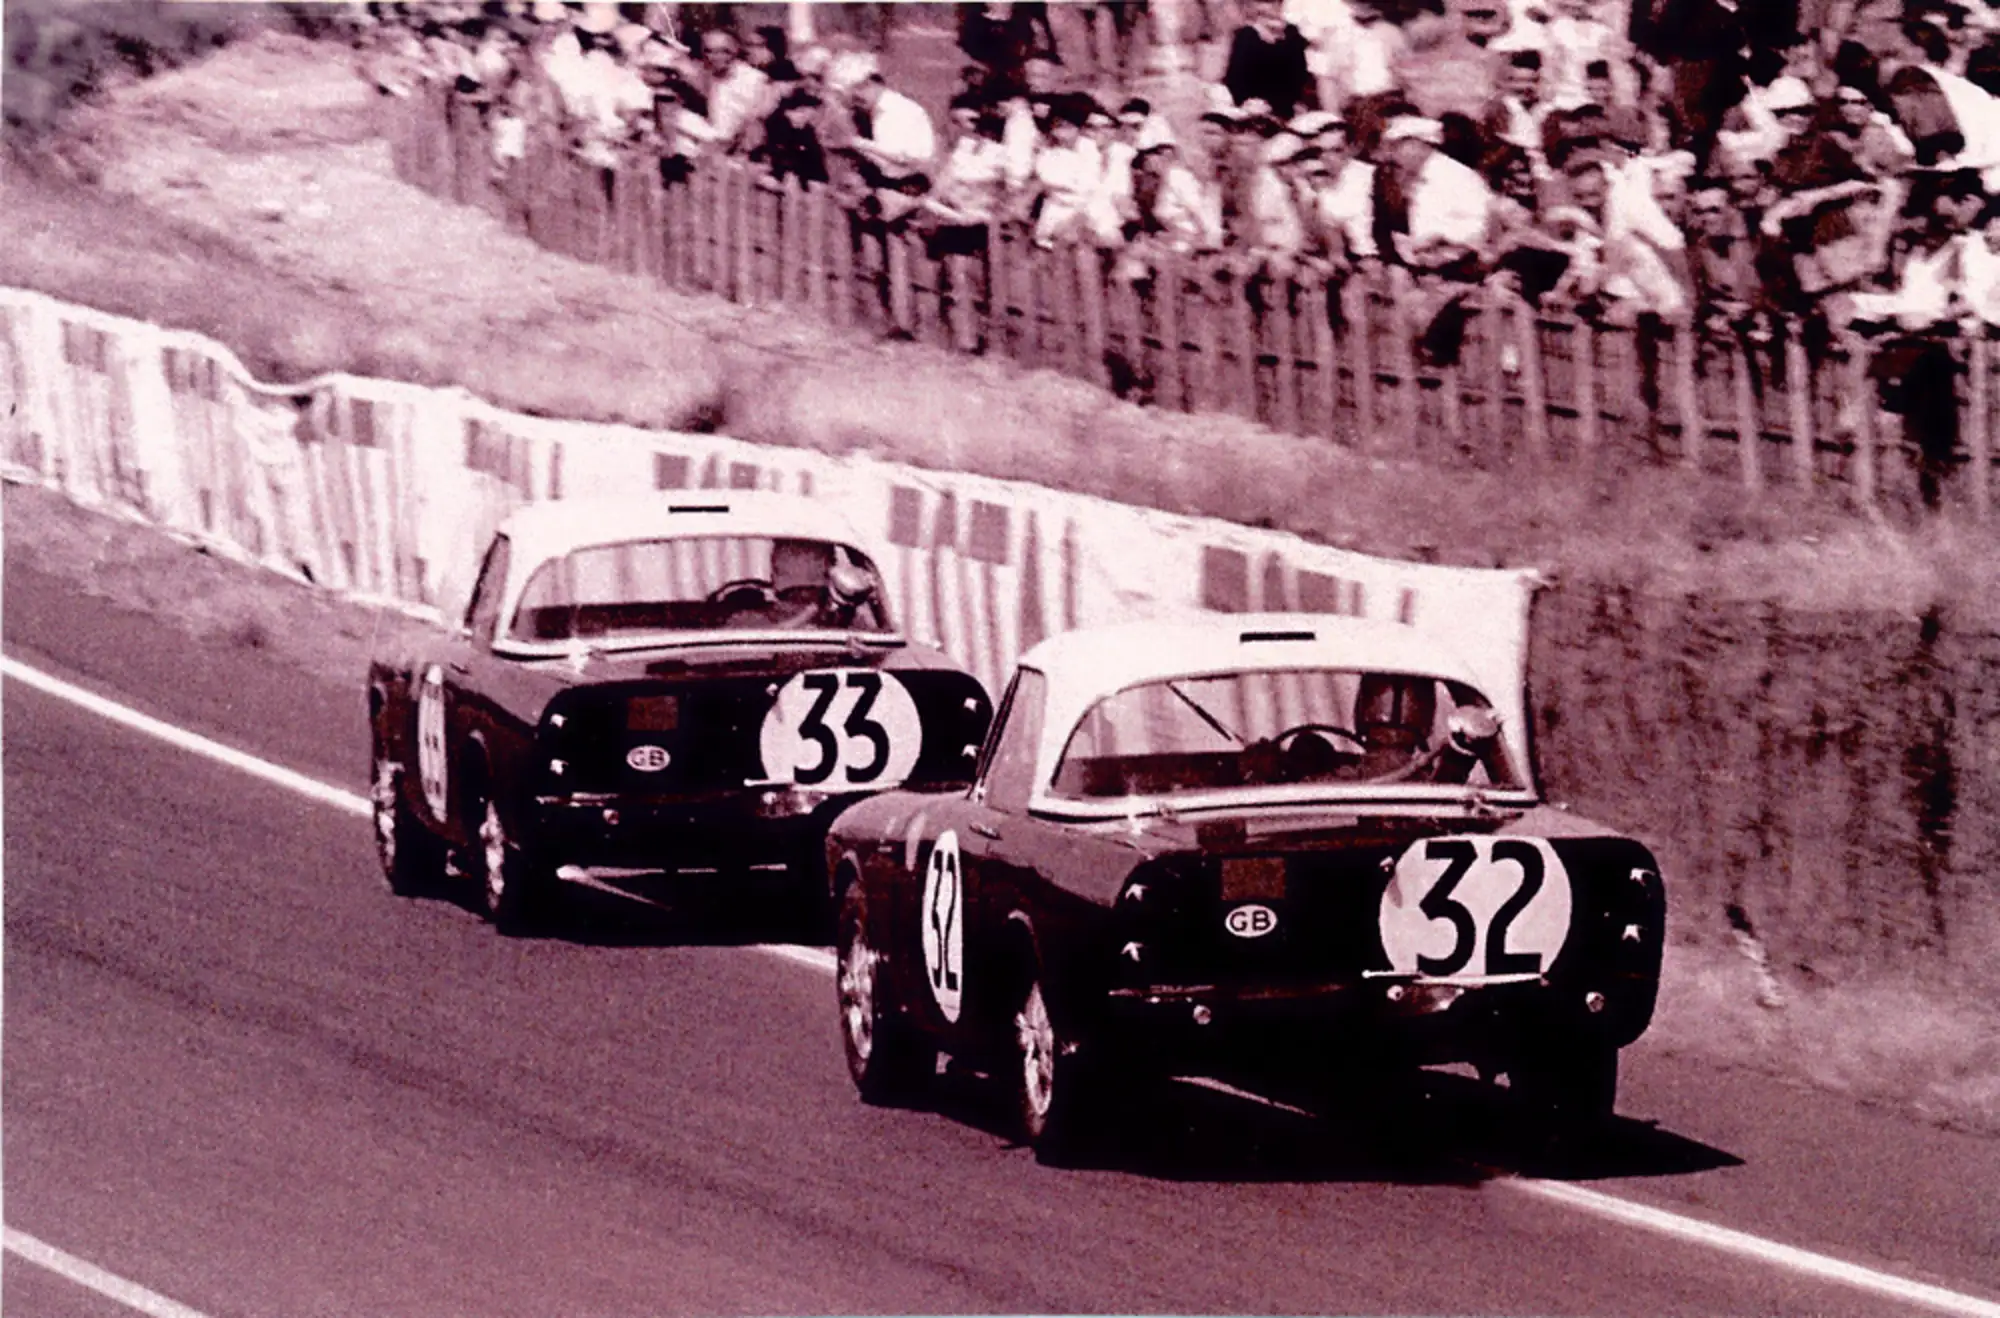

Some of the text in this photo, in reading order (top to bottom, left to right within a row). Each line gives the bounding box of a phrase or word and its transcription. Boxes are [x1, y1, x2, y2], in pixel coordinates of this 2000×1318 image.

[631, 748, 666, 767] GB
[793, 671, 890, 784] 33
[931, 848, 959, 991] 32
[1230, 909, 1271, 932] GB
[1415, 840, 1545, 976] 32
